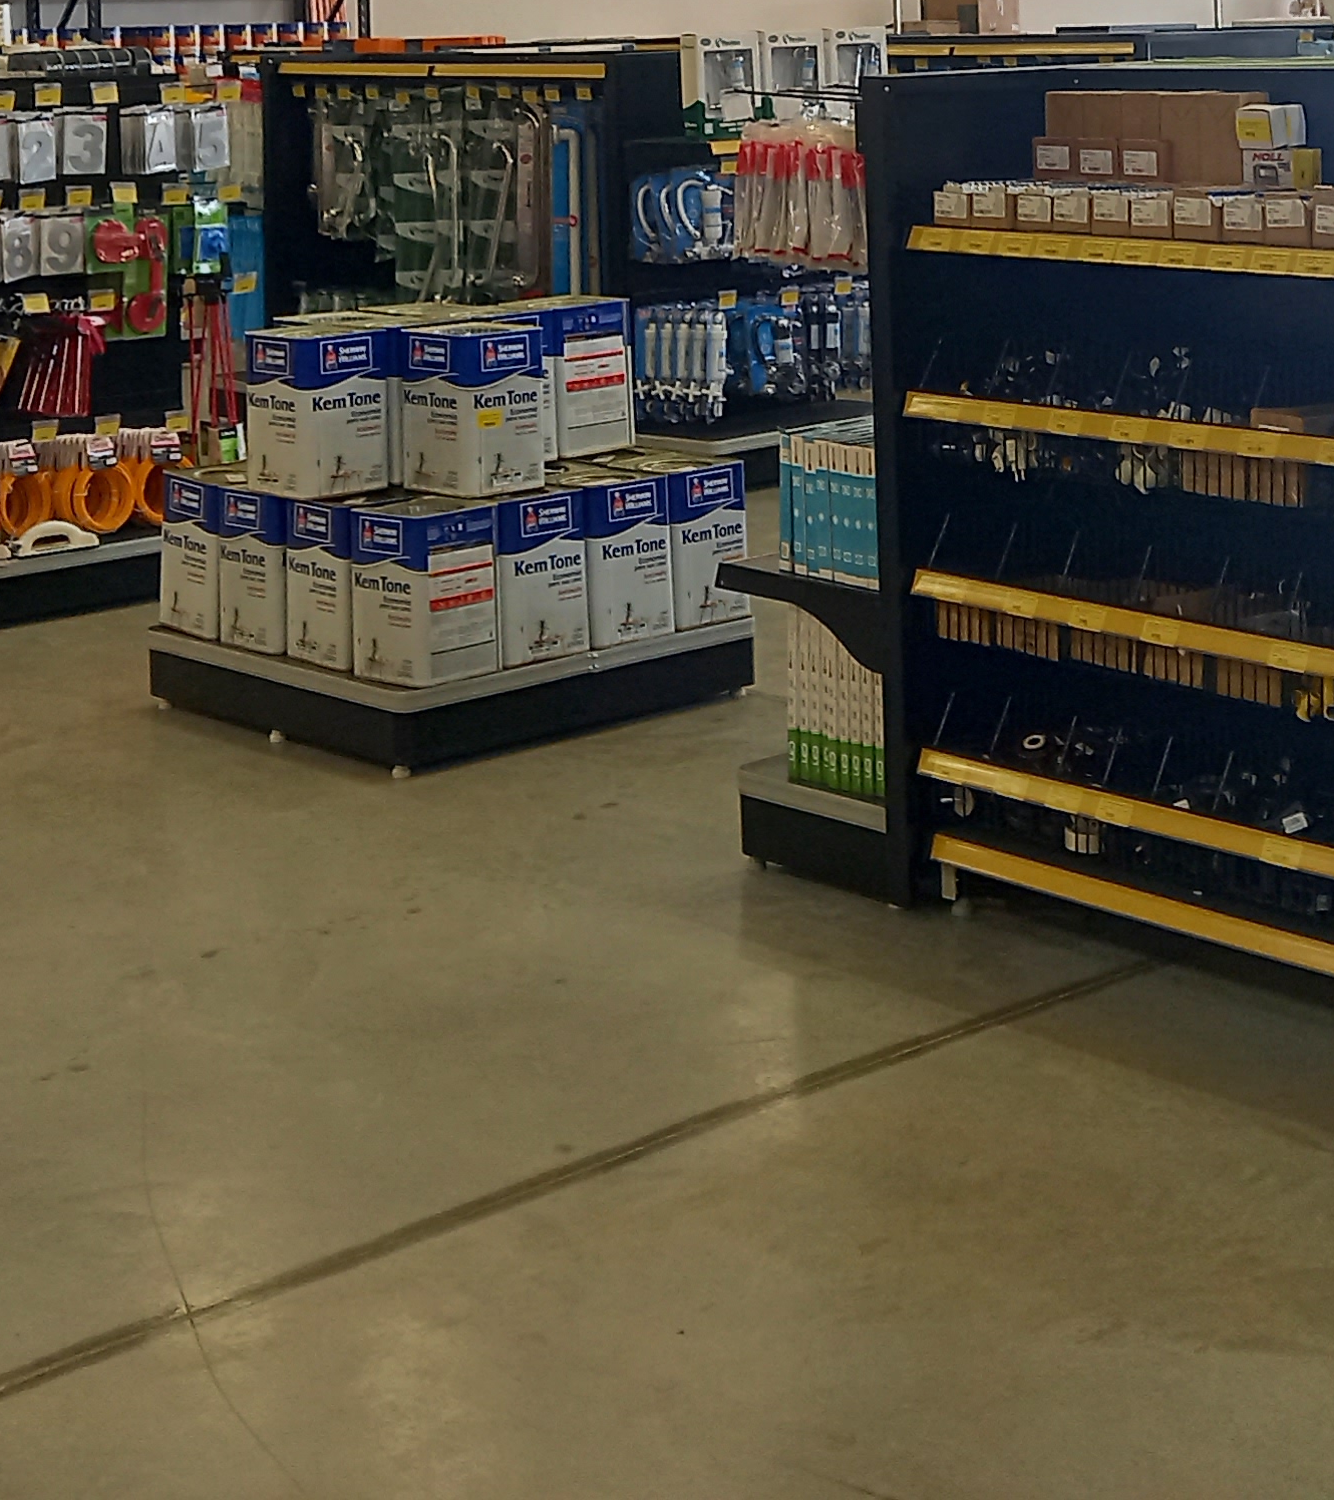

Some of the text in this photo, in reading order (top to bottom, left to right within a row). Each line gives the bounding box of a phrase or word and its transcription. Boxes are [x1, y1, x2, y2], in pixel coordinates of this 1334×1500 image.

[21, 130, 53, 181] 2
[69, 123, 104, 172] 3
[197, 112, 227, 166] 5
[4, 227, 32, 277] 8
[46, 224, 75, 273] 9
